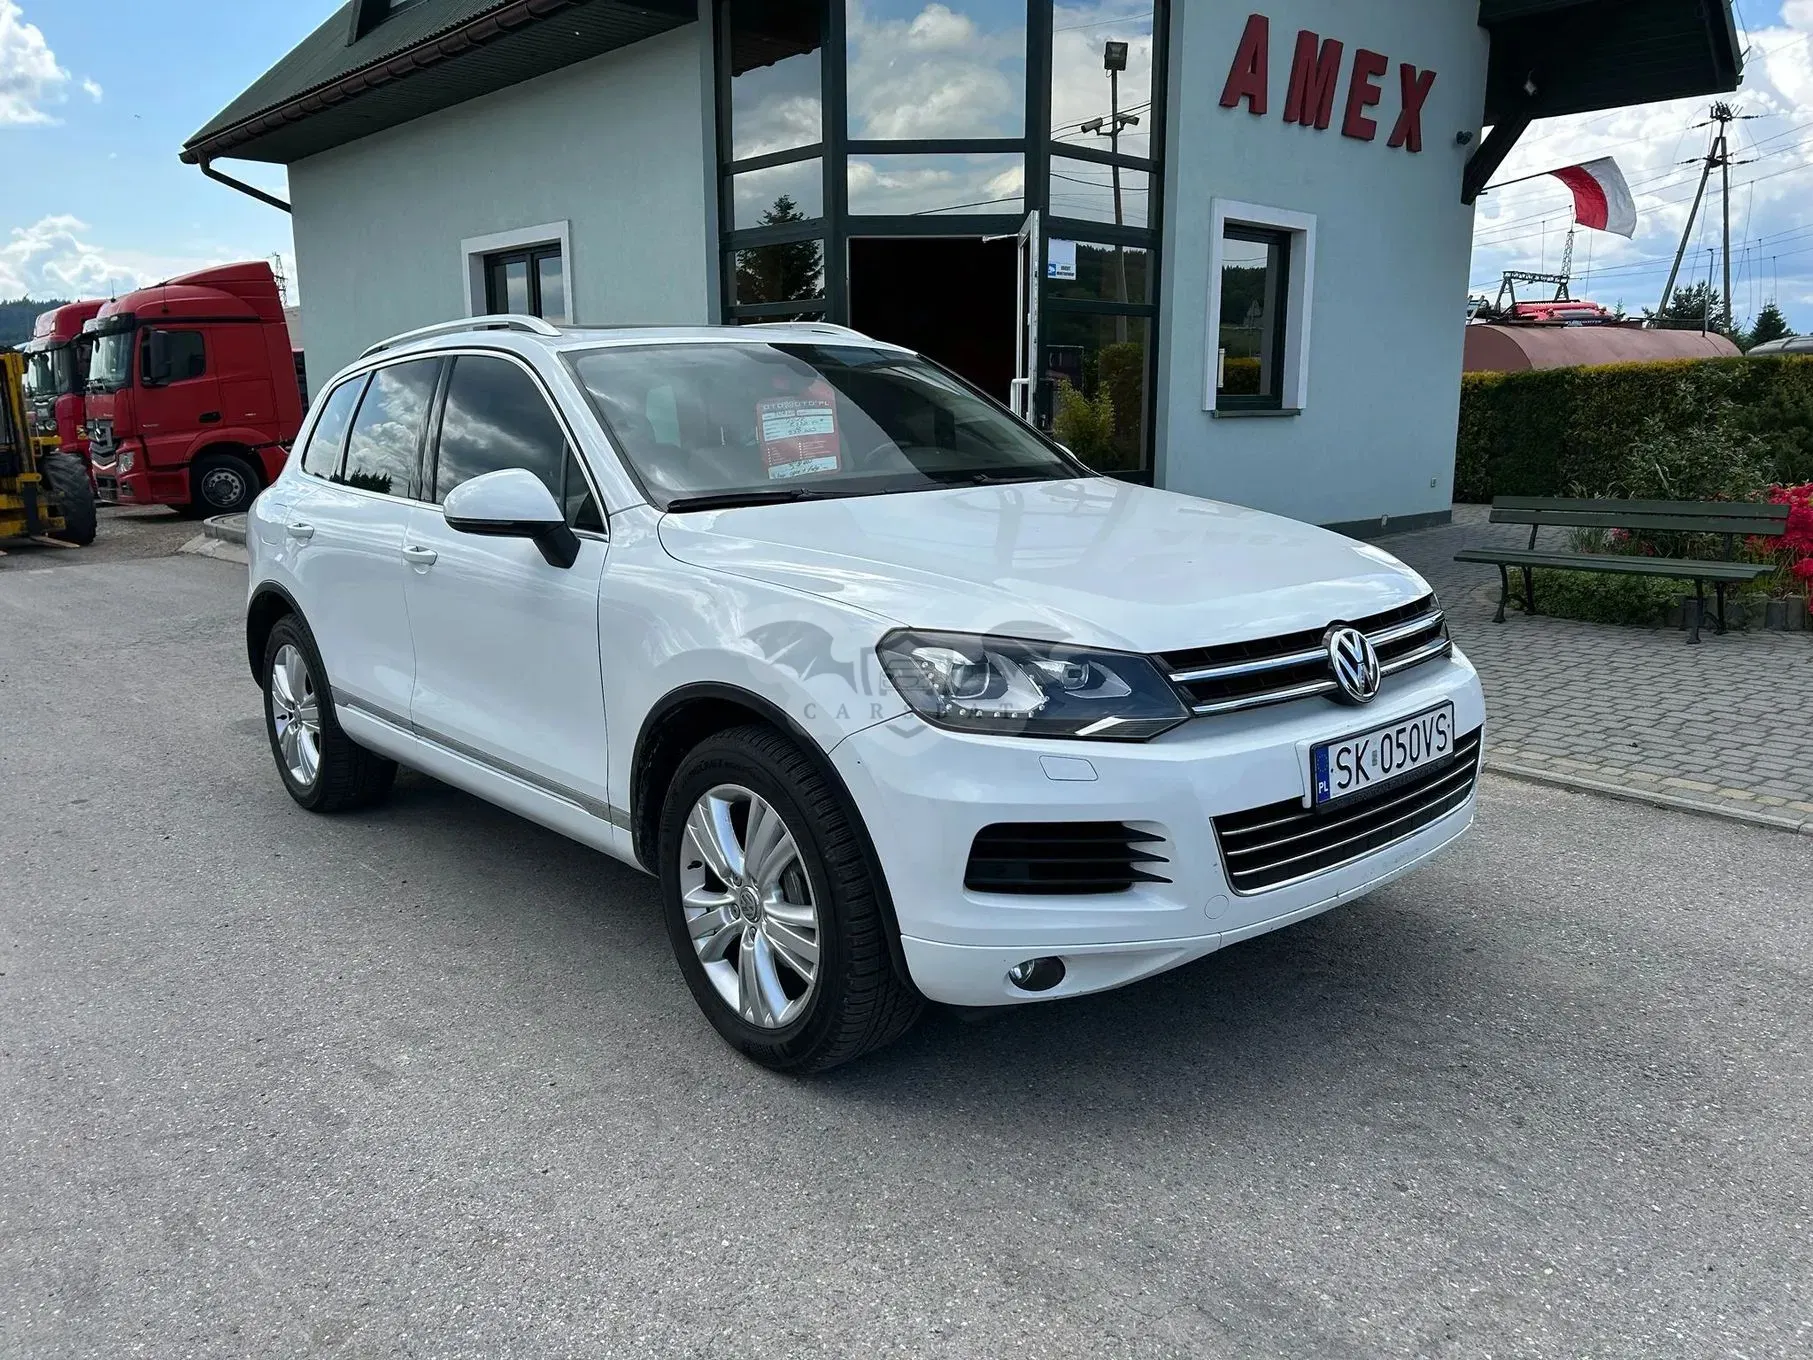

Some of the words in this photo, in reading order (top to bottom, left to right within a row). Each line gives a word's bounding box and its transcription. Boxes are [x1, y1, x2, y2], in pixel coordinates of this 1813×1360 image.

[1218, 13, 1438, 153] AMEX
[1318, 781, 1329, 794] PL
[1335, 739, 1371, 789] SK
[1380, 713, 1449, 774] 050VS
